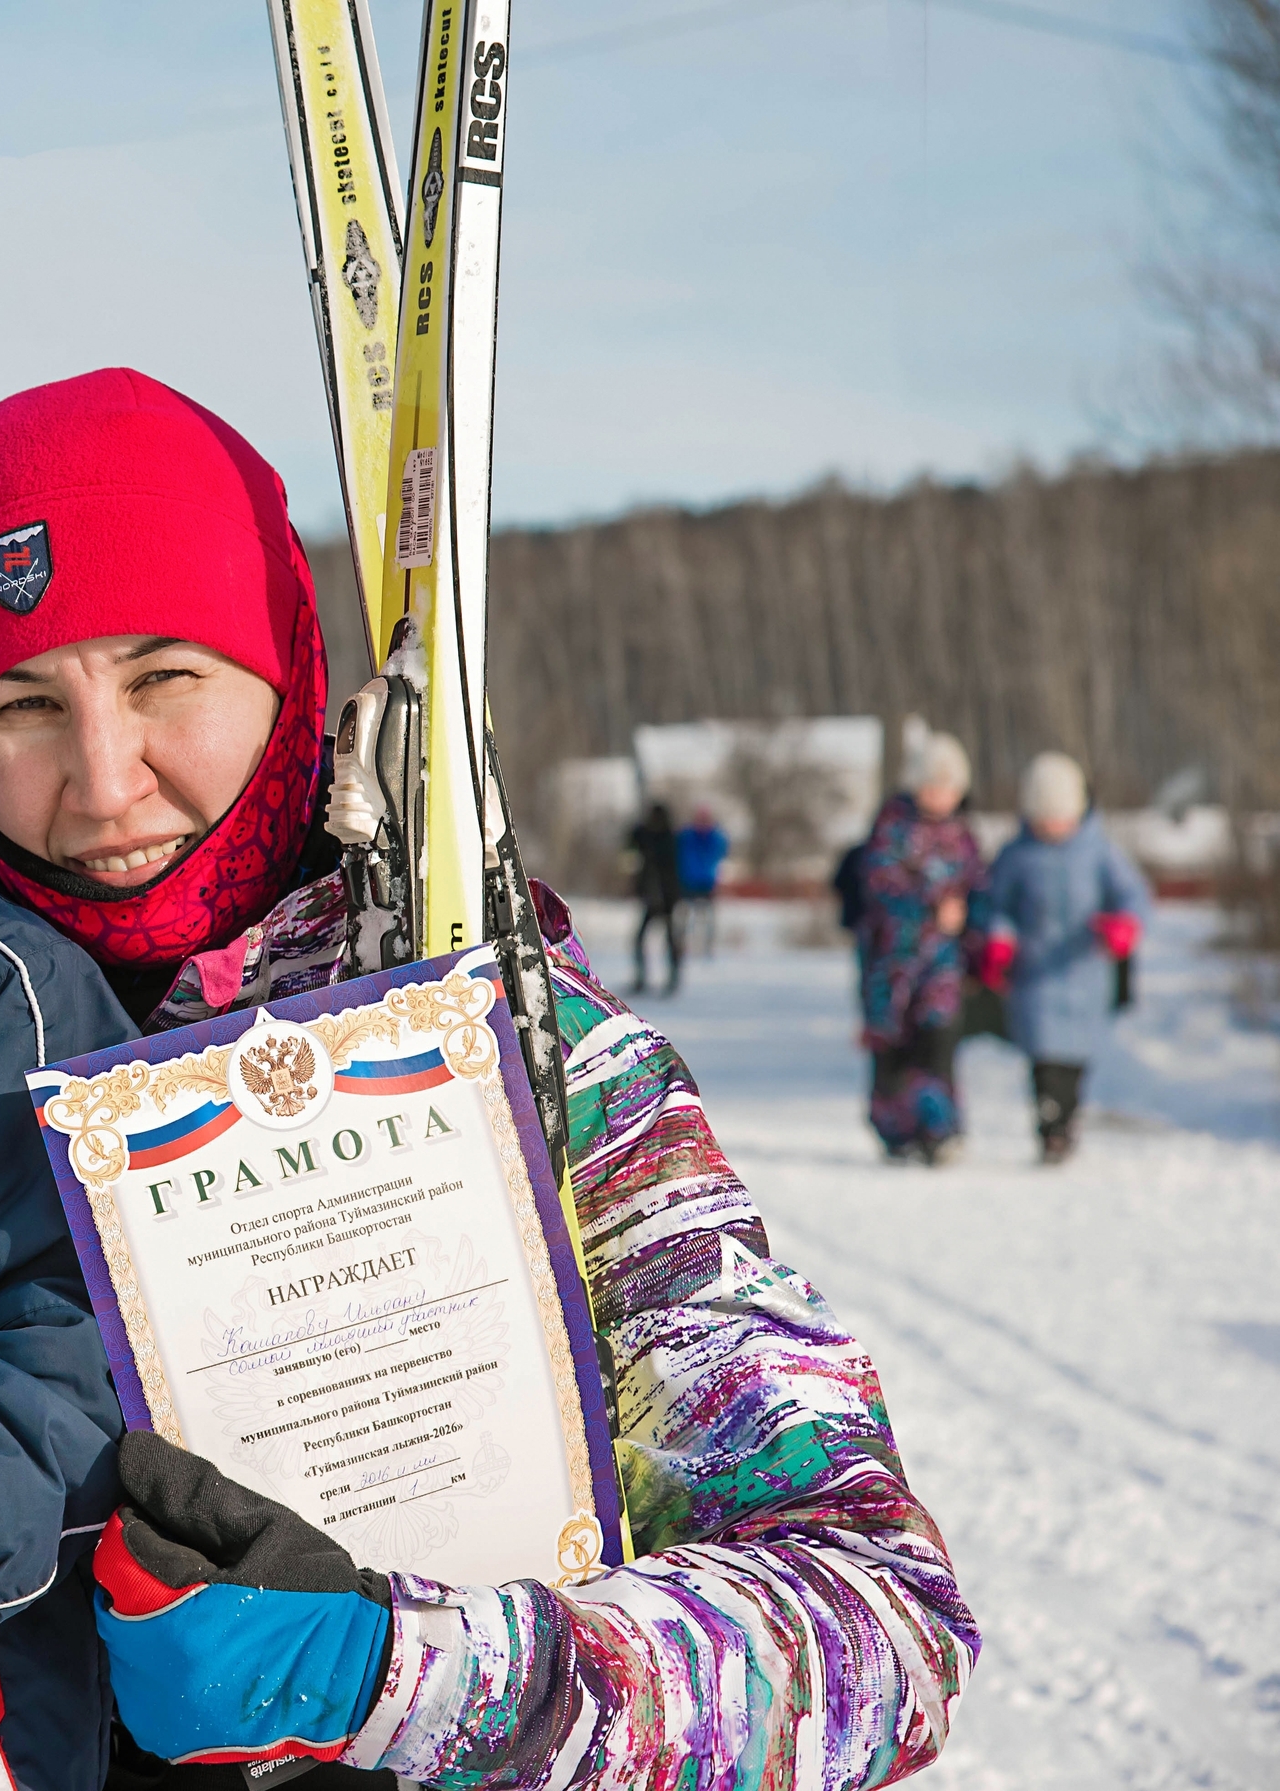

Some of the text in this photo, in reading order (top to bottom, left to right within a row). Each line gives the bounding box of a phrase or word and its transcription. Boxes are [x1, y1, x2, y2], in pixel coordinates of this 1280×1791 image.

[434, 7, 453, 113] skatecut
[466, 40, 506, 162] RCS
[415, 261, 434, 336] RCS
[148, 1106, 451, 1215] ГРАМОТА
[187, 1181, 463, 1267] муниципального района Туймазинский район
[230, 1176, 413, 1235] Отдел спорта Администрации
[251, 1213, 412, 1266] Республики Башкортостан
[267, 1247, 415, 1306] НАГРАЖДАЕТ
[274, 1321, 441, 1376] занявшую (его) место
[277, 1349, 453, 1407] в соревнованиях на первенство
[240, 1361, 498, 1444] муниципального района Туймазинский район
[303, 1401, 452, 1452] Республики Башкортостан
[304, 1423, 464, 1478] «Туймазинская лыжня-2026»
[319, 1484, 351, 1501] среди
[323, 1473, 466, 1525] на дистанции км
